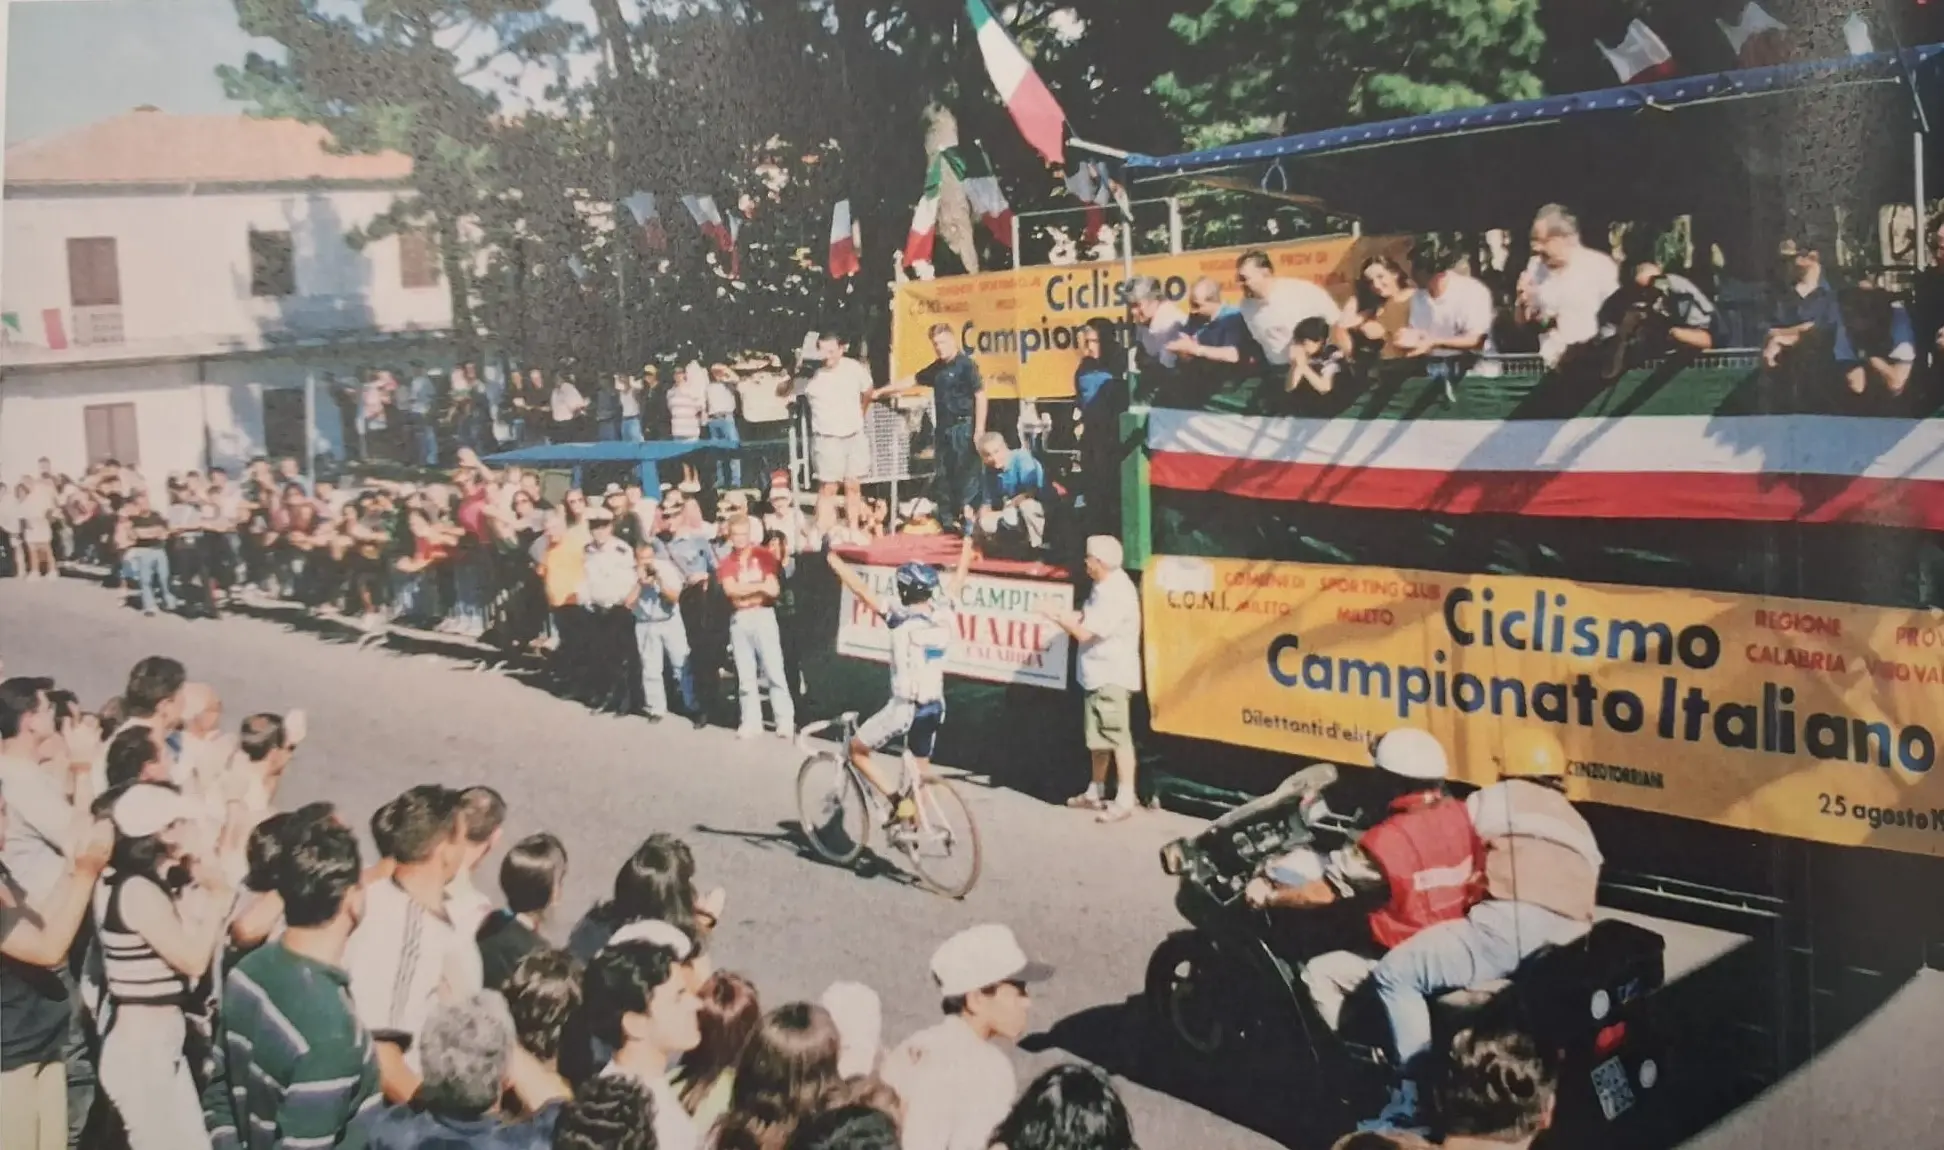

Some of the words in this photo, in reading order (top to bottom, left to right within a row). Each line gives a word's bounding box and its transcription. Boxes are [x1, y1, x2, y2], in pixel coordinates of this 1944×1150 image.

[1046, 269, 1187, 311] Cicliso
[1320, 575, 1399, 598] SPORTING
[1402, 581, 1443, 601] CLUB
[1443, 586, 1721, 670] Ciclismo
[1754, 608, 1843, 638] REGIONE
[1745, 642, 1847, 674] CALABRIA
[1266, 632, 1645, 734] Campionato
[1657, 676, 1936, 773] Italiano
[1241, 708, 1324, 737] Dilettanti
[1818, 792, 1847, 817] 25
[1851, 803, 1929, 830] agosto
